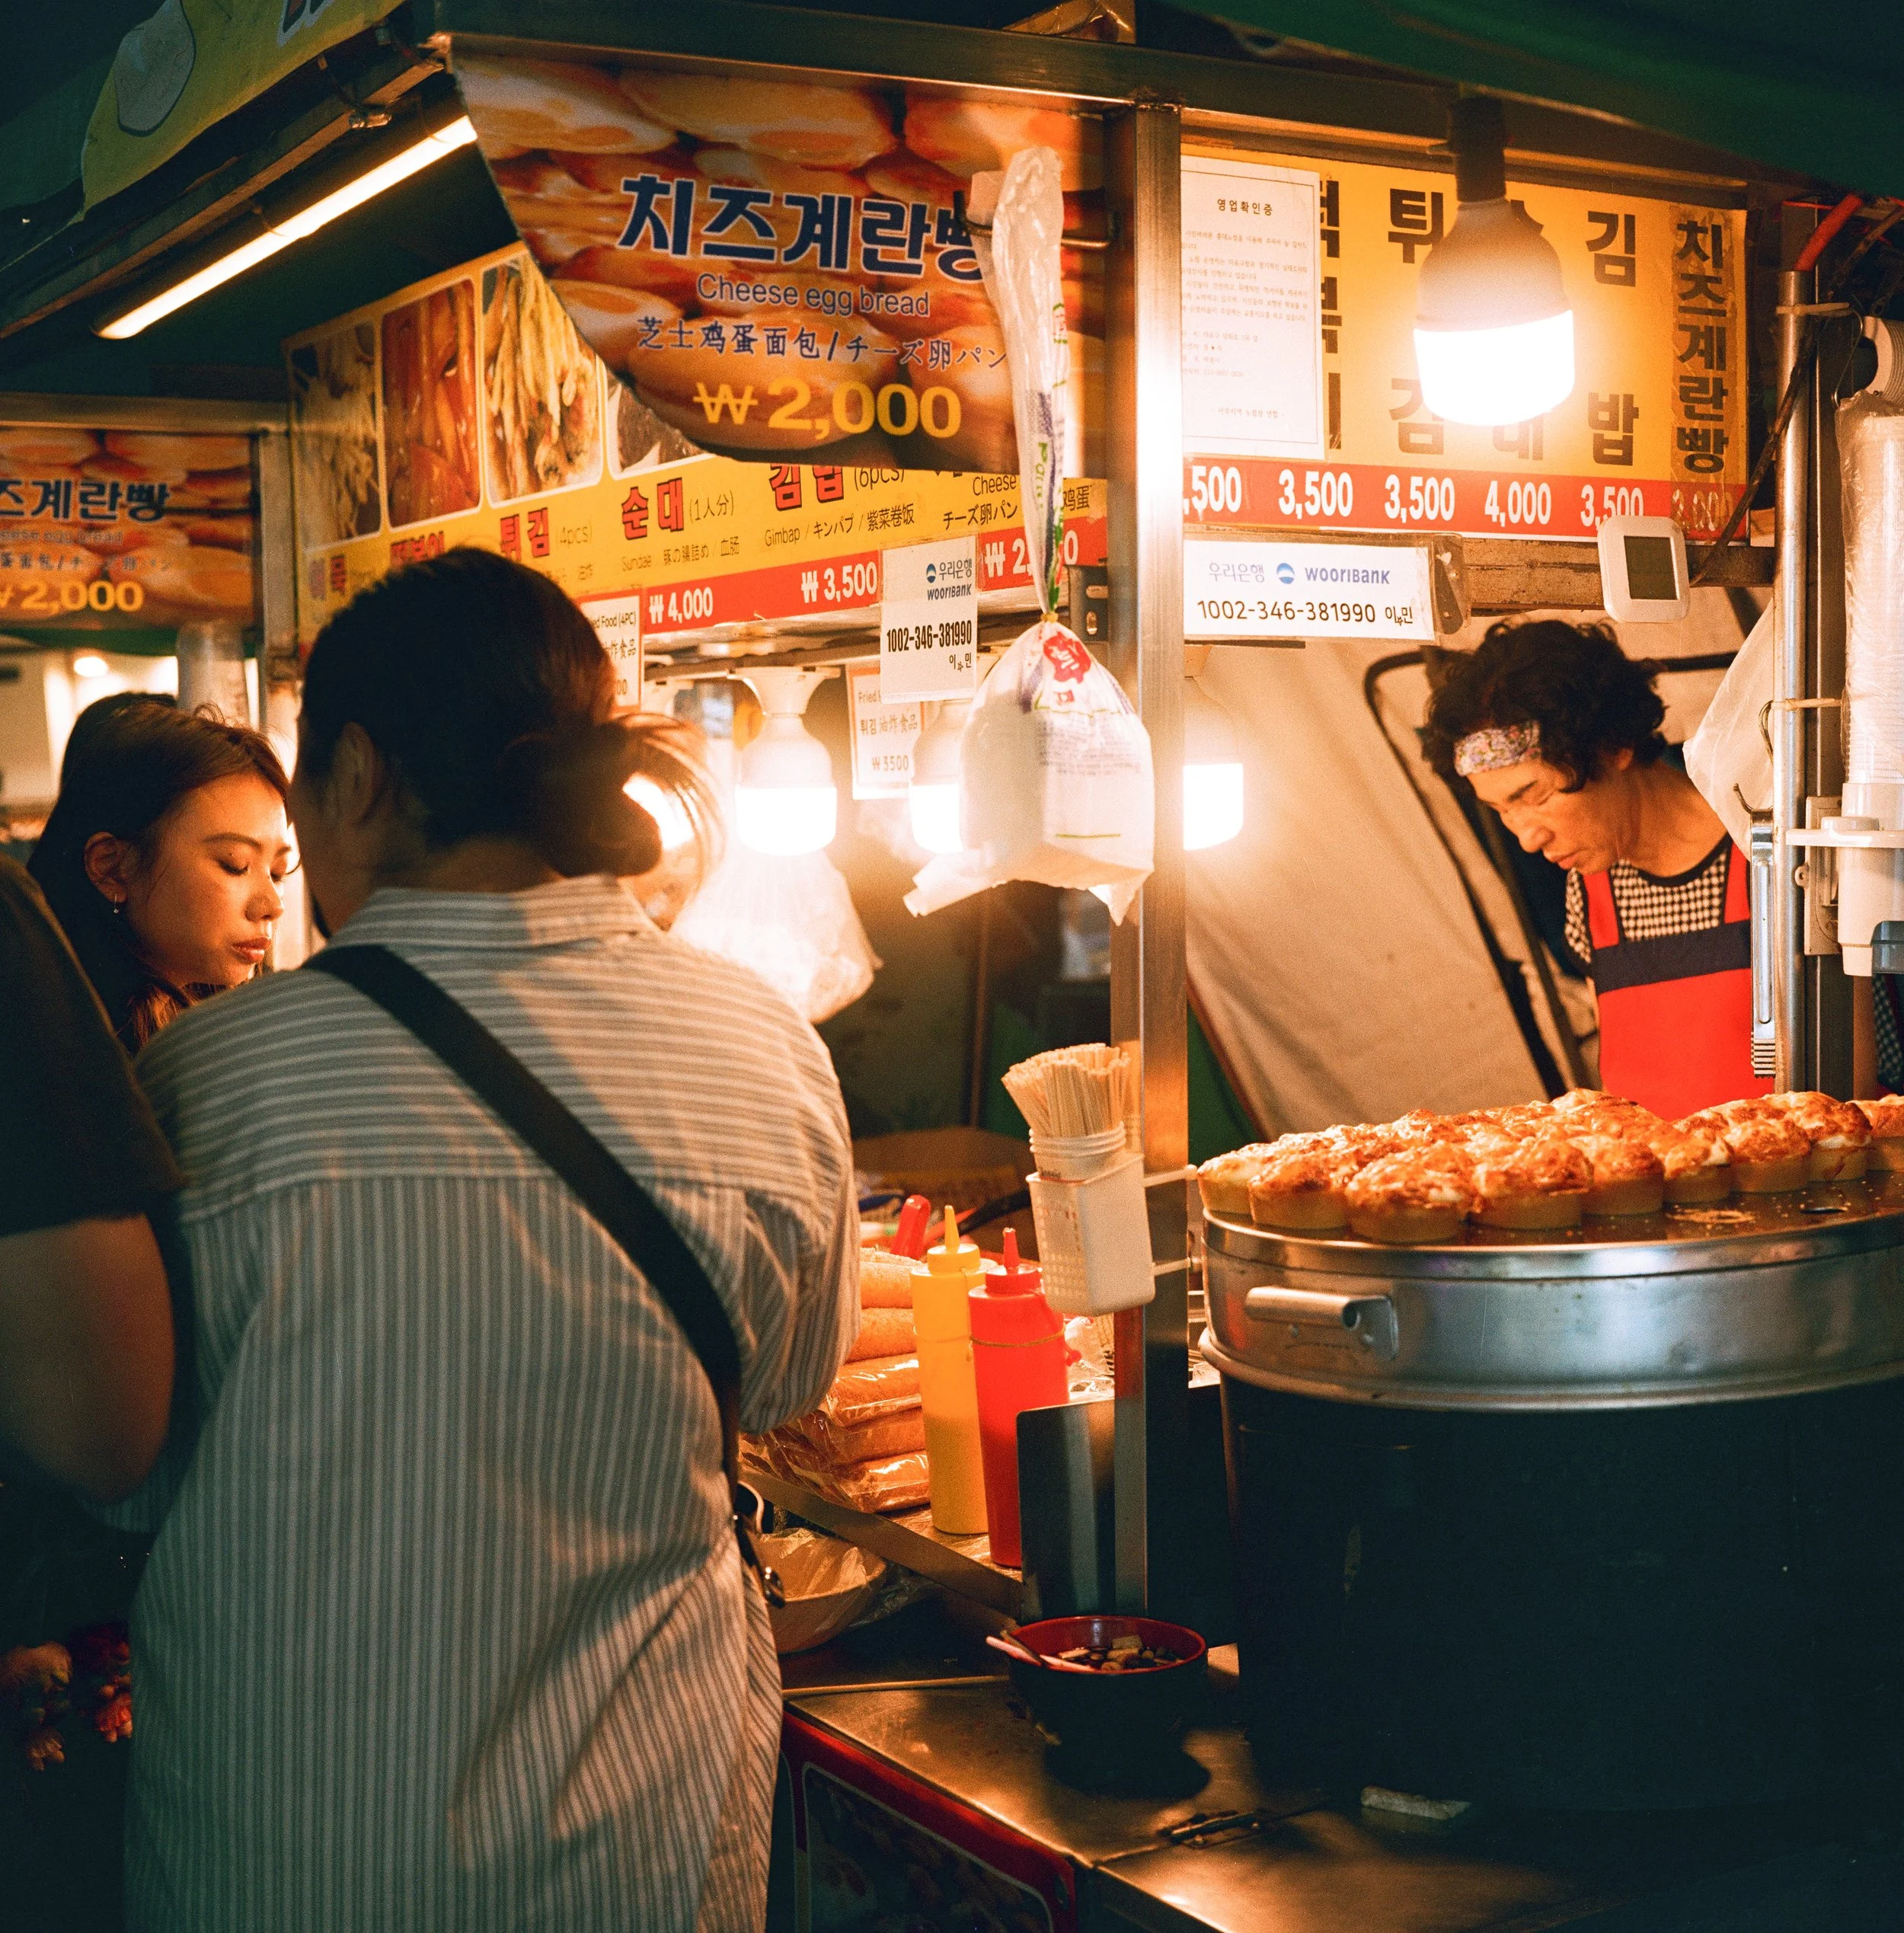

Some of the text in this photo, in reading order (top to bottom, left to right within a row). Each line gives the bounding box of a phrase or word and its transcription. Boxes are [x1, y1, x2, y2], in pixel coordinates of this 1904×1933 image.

[1218, 199, 1273, 216] 영업확인증
[698, 273, 928, 316] Cheese egg bread
[1586, 210, 1640, 467] 김밥
[1675, 219, 1730, 474] 치즈계란빵
[973, 474, 1017, 496] Cheese
[1278, 469, 1353, 519] 3,500
[1385, 474, 1455, 523] 3,500
[1484, 481, 1551, 527] 4,000
[621, 477, 684, 541] 순대
[765, 527, 800, 547] Gimbap
[823, 561, 878, 603] 3,500
[939, 558, 973, 581] 우리은행
[1209, 562, 1265, 584] 우리은행
[668, 586, 713, 624] 4,000
[1197, 599, 1375, 624] 1002-346-381990
[887, 619, 973, 653] 1002-346-381990
[883, 754, 909, 772] 3500
